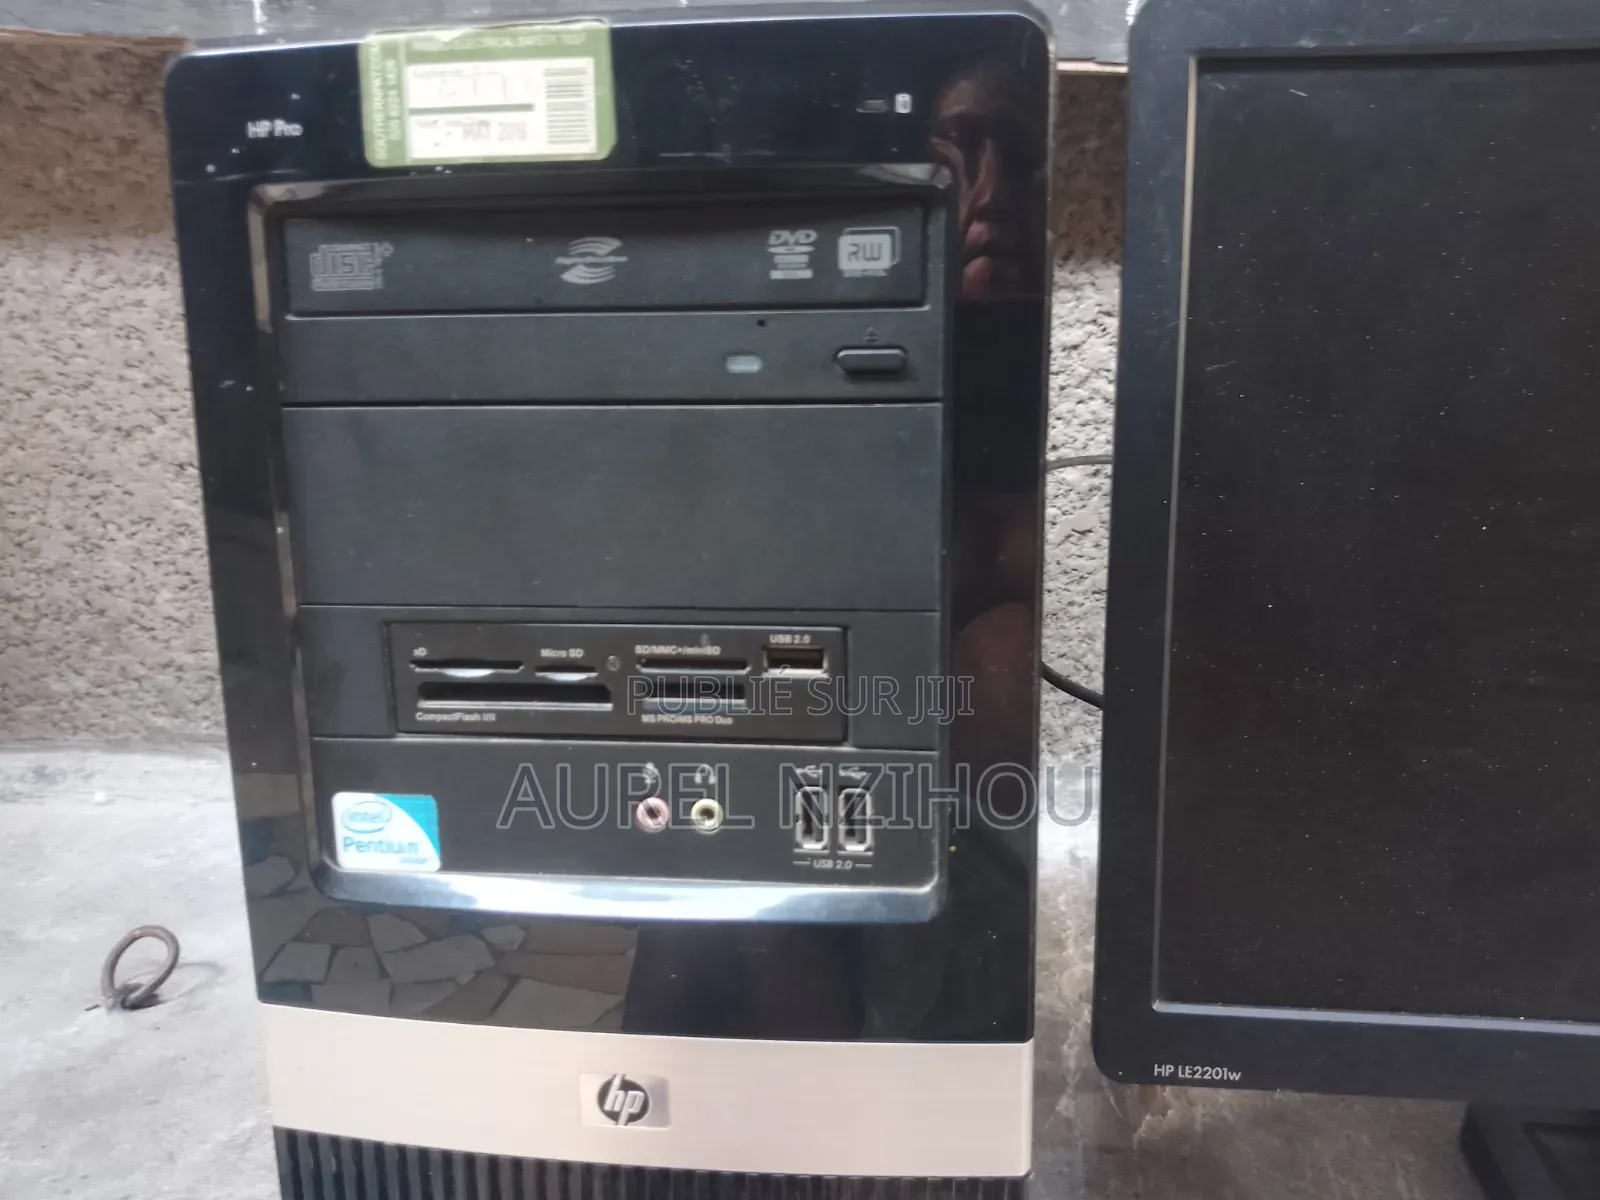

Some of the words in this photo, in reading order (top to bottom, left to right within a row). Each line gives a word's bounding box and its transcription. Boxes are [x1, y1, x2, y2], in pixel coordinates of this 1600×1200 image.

[247, 120, 273, 138] HP
[274, 118, 304, 136] Pro
[768, 229, 818, 247] DVD
[847, 242, 883, 262] RW
[769, 635, 791, 644] USB
[540, 648, 567, 658] Micro
[569, 648, 585, 658] SD
[415, 711, 481, 722] CompactFlash
[343, 835, 419, 855] Pentium
[813, 859, 833, 869] USB
[835, 859, 853, 870] 2.0
[1153, 1063, 1175, 1078] HP
[1177, 1064, 1242, 1081] LE2201w
[603, 1073, 646, 1126] hp
